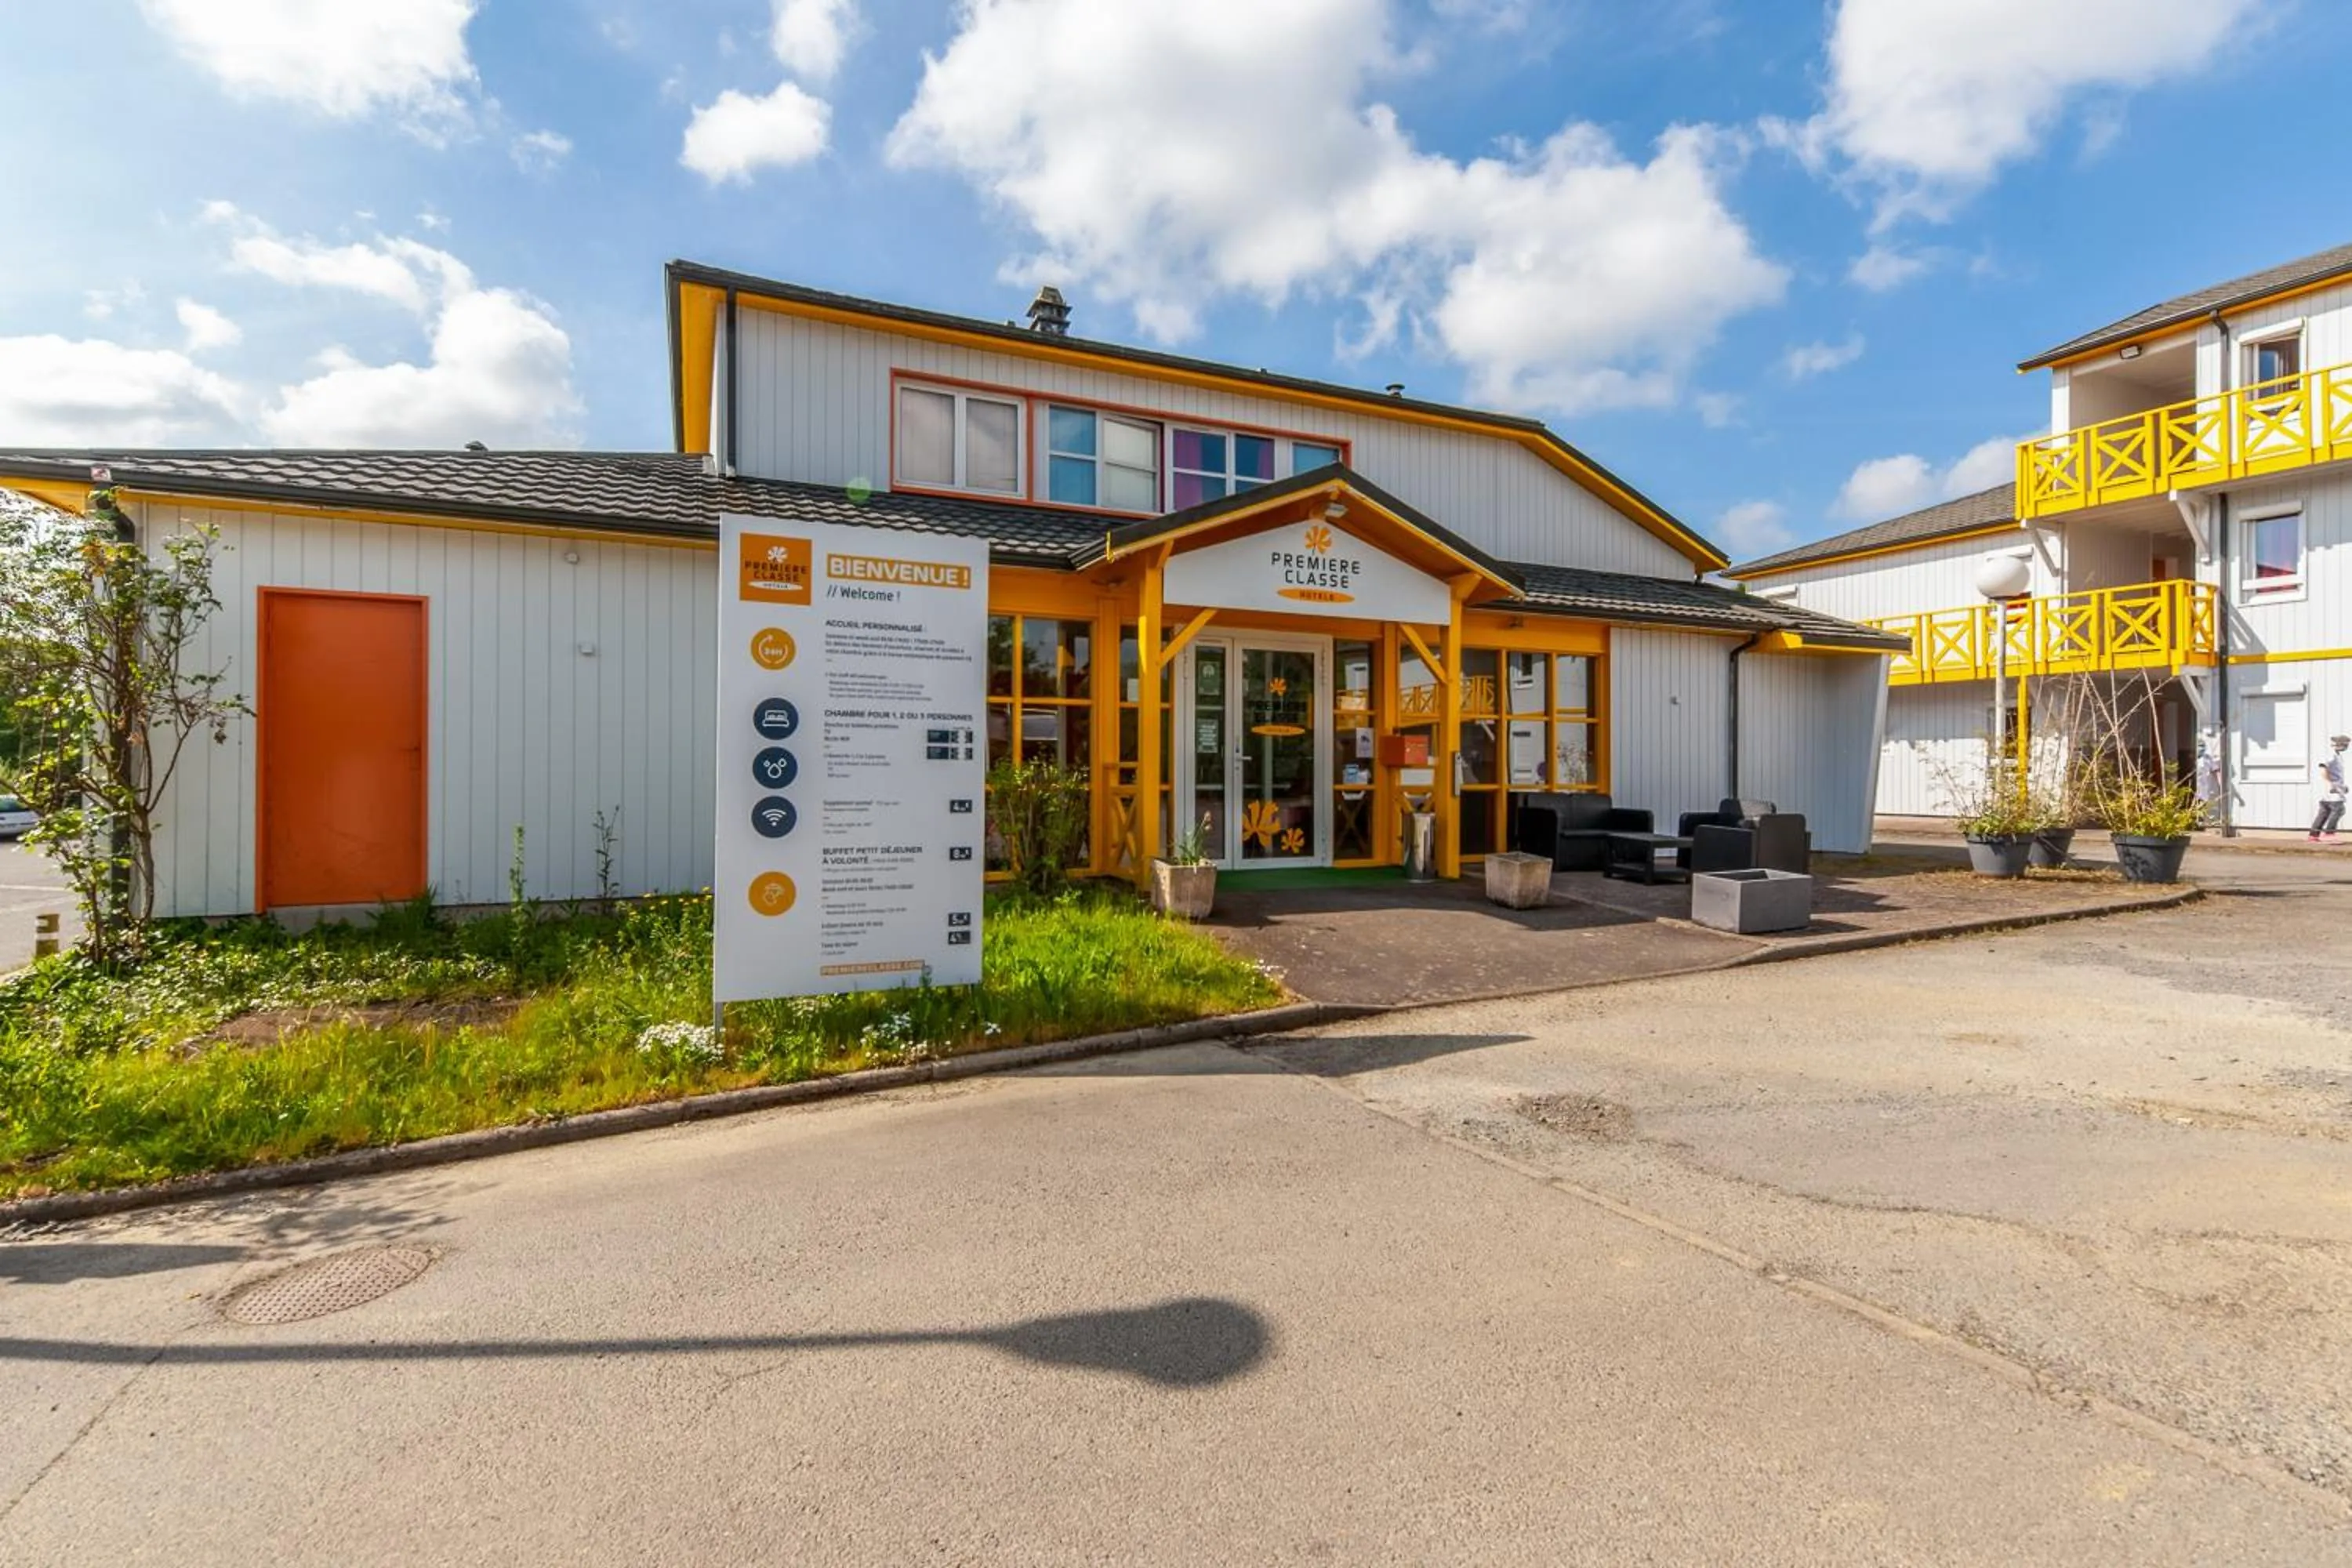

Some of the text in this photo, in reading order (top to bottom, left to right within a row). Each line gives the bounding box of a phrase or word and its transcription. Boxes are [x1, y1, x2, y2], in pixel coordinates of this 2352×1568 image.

[829, 557, 958, 586] BIENVENUE
[1271, 551, 1360, 575] PREMIERE
[1284, 570, 1349, 589] CLASSE
[841, 586, 894, 601] Welcome
[826, 619, 859, 630] ACCUEIL
[822, 847, 854, 855] BUFFET
